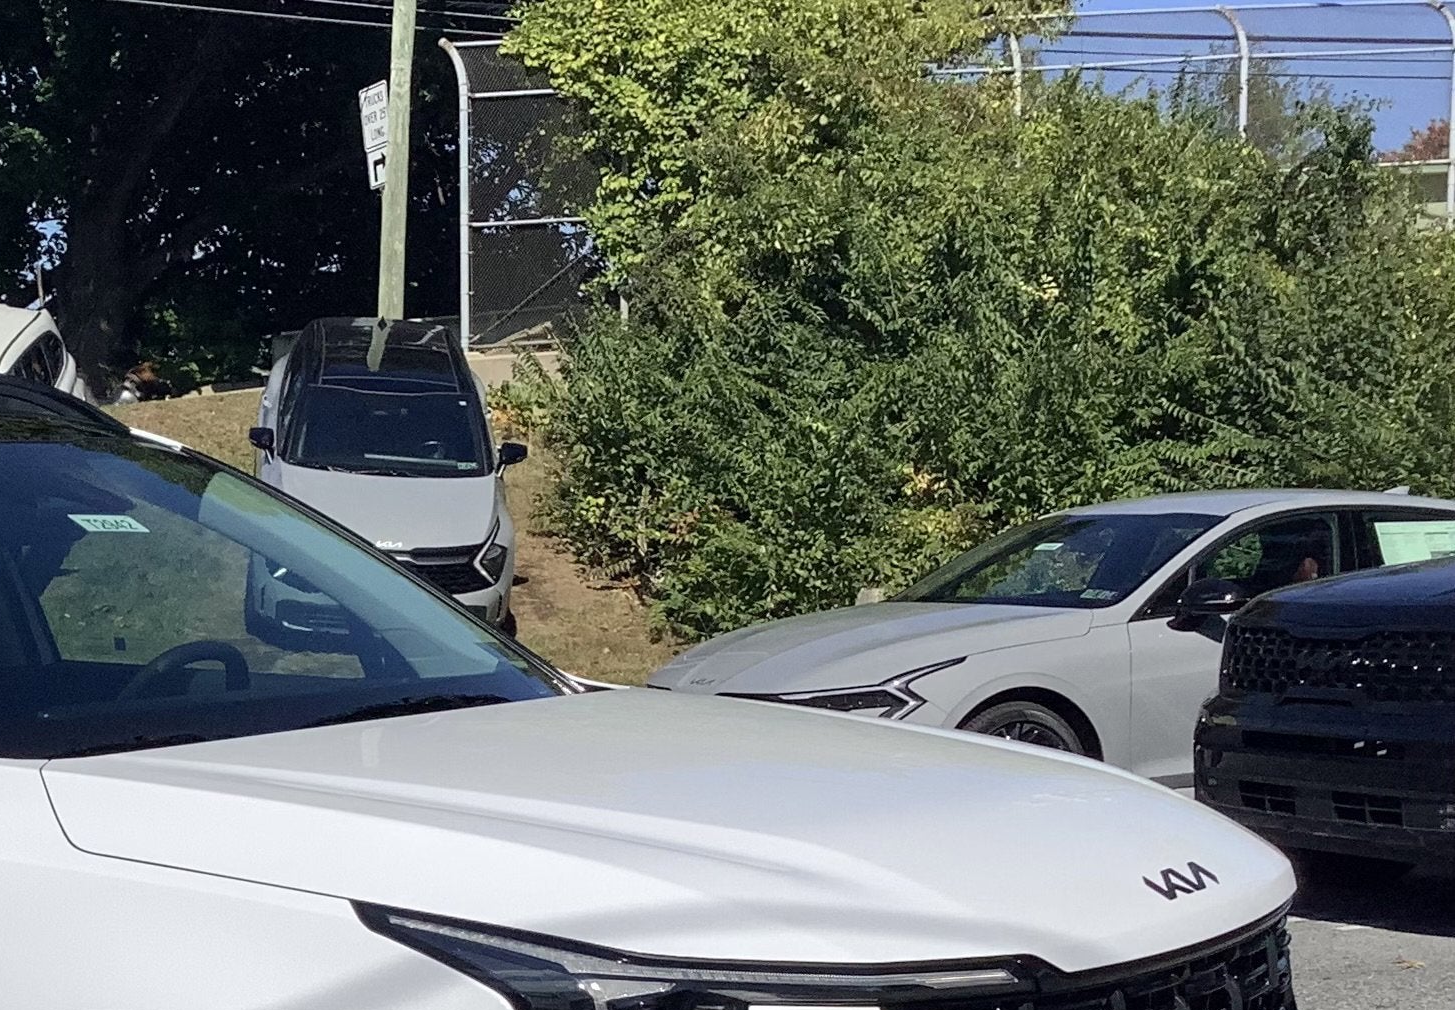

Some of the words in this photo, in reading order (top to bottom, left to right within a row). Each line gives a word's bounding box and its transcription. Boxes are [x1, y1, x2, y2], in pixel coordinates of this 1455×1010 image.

[363, 111, 377, 126] OVER
[371, 126, 385, 141] LONG
[1142, 861, 1220, 901] KIA
